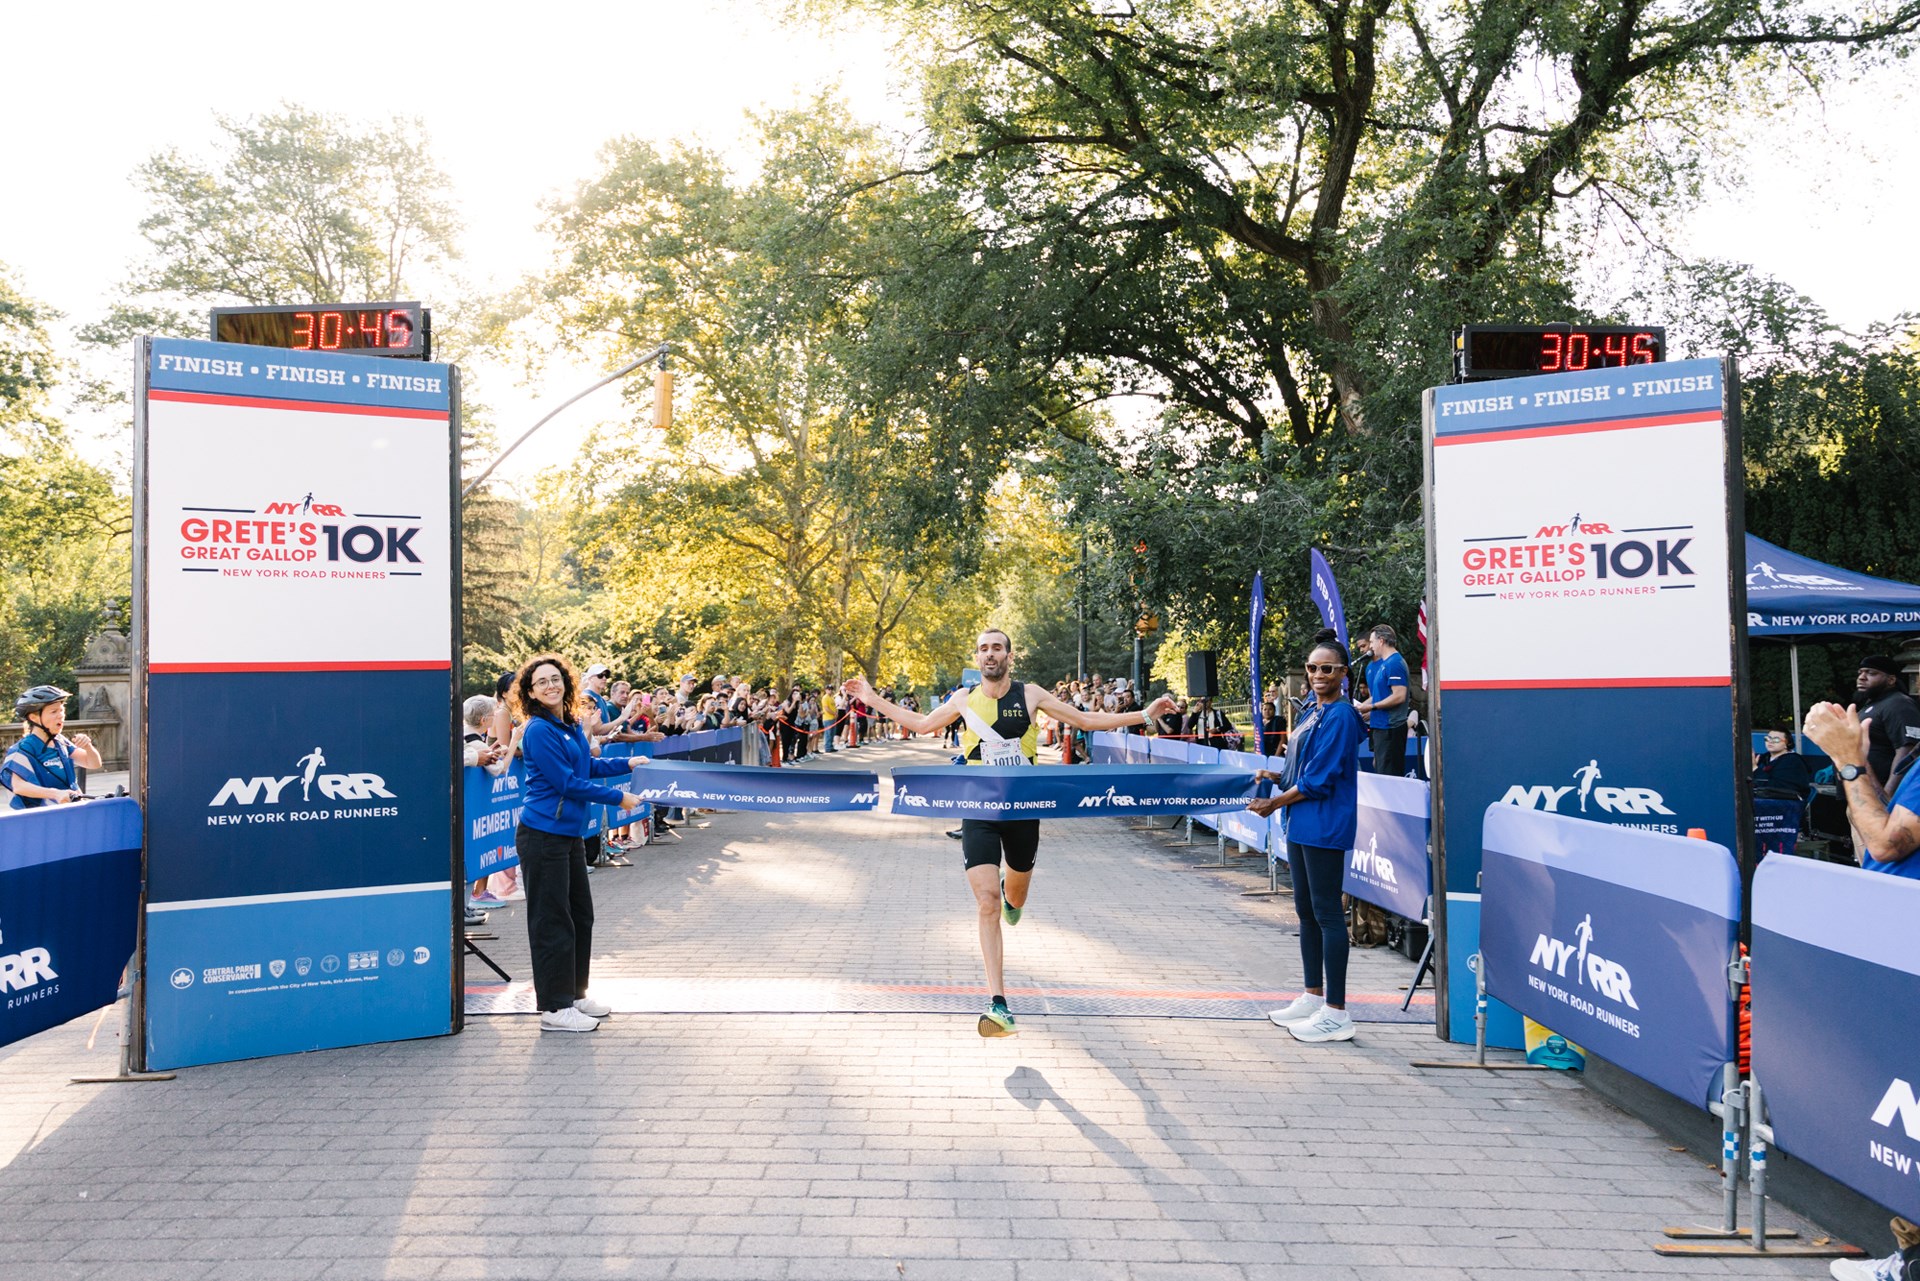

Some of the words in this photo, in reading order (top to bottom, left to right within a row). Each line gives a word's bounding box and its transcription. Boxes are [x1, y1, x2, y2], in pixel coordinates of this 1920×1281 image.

[158, 353, 243, 377] FINISH
[266, 363, 345, 386] FINISH
[366, 373, 441, 393] FINISH
[1441, 395, 1514, 417] FINISH
[1534, 385, 1610, 407] FINISH
[1632, 375, 1714, 397] FINISH
[180, 518, 317, 546] GRETE'S
[322, 525, 424, 563] 10K
[180, 546, 241, 560] GREAT
[246, 548, 317, 562] GALLOP
[1462, 542, 1585, 571] GRETE'S
[1590, 537, 1697, 579] 10K
[223, 568, 252, 577] NEW
[256, 569, 288, 578] YORK
[293, 570, 327, 579] ROAD
[331, 571, 386, 580] RUNNERS
[1463, 572, 1515, 587] GREAT
[1519, 569, 1586, 584] GALLOP
[1499, 592, 1526, 600] NEW
[1528, 590, 1559, 599] YORK
[1563, 588, 1595, 597] ROAD
[1600, 586, 1657, 596] RUNNERS
[1772, 616, 1804, 626] NEW
[1808, 614, 1847, 625] YORK
[1850, 613, 1890, 624] ROAD
[1002, 709, 1023, 717] GSTC
[208, 773, 398, 806] NYRR
[702, 792, 726, 801] NEW
[728, 794, 755, 803] YORK
[756, 795, 784, 804] ROAD
[786, 795, 831, 804] RUNNERS
[1139, 798, 1161, 806] NEW
[1162, 797, 1188, 806] YORK
[1190, 797, 1217, 806] ROAD
[207, 814, 242, 826] NEW
[246, 812, 285, 824] YORK
[289, 810, 330, 821] ROAD
[334, 807, 399, 819] RUNNERS
[932, 799, 954, 808] NEW
[956, 800, 982, 809] YORK
[983, 801, 1011, 810] ROAD
[1013, 800, 1057, 810] RUNNERS
[472, 810, 511, 841] MEMBER
[1351, 848, 1398, 885] NYRR
[203, 966, 235, 976] CENTRAL
[235, 964, 254, 974] PARK
[203, 972, 254, 984] CONSERVANCY
[1529, 933, 1640, 1011] NYRR
[7, 984, 60, 1010] RUNNERS
[1528, 974, 1550, 992] NEW
[1547, 983, 1569, 1005] YORK
[1570, 994, 1595, 1016] ROAD
[1596, 1006, 1640, 1039] RUNNERS
[1870, 1140, 1912, 1175] NEW
